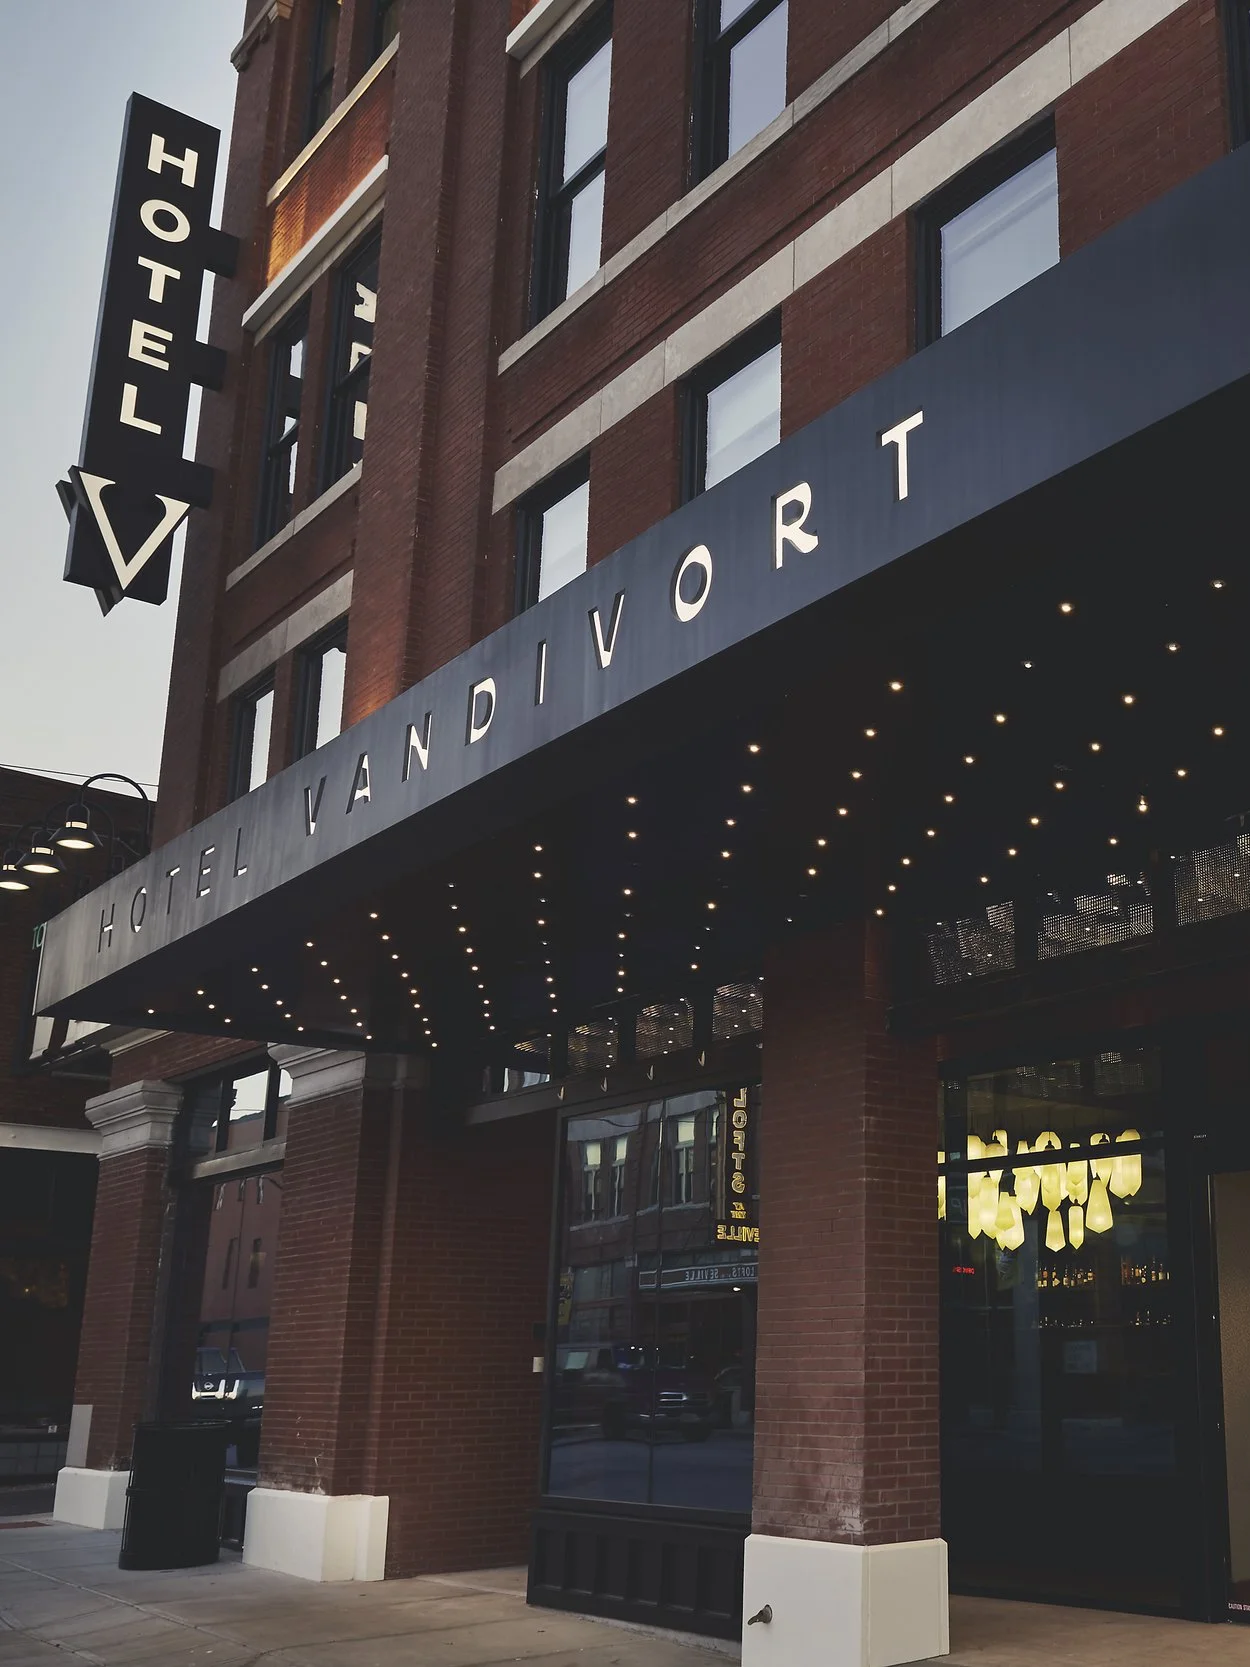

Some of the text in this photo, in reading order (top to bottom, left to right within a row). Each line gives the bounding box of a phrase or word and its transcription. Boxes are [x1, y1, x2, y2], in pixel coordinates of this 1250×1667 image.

[119, 132, 199, 435] HOTEL
[78, 470, 191, 591] V
[97, 409, 925, 954] HOTEL VANDIVORT
